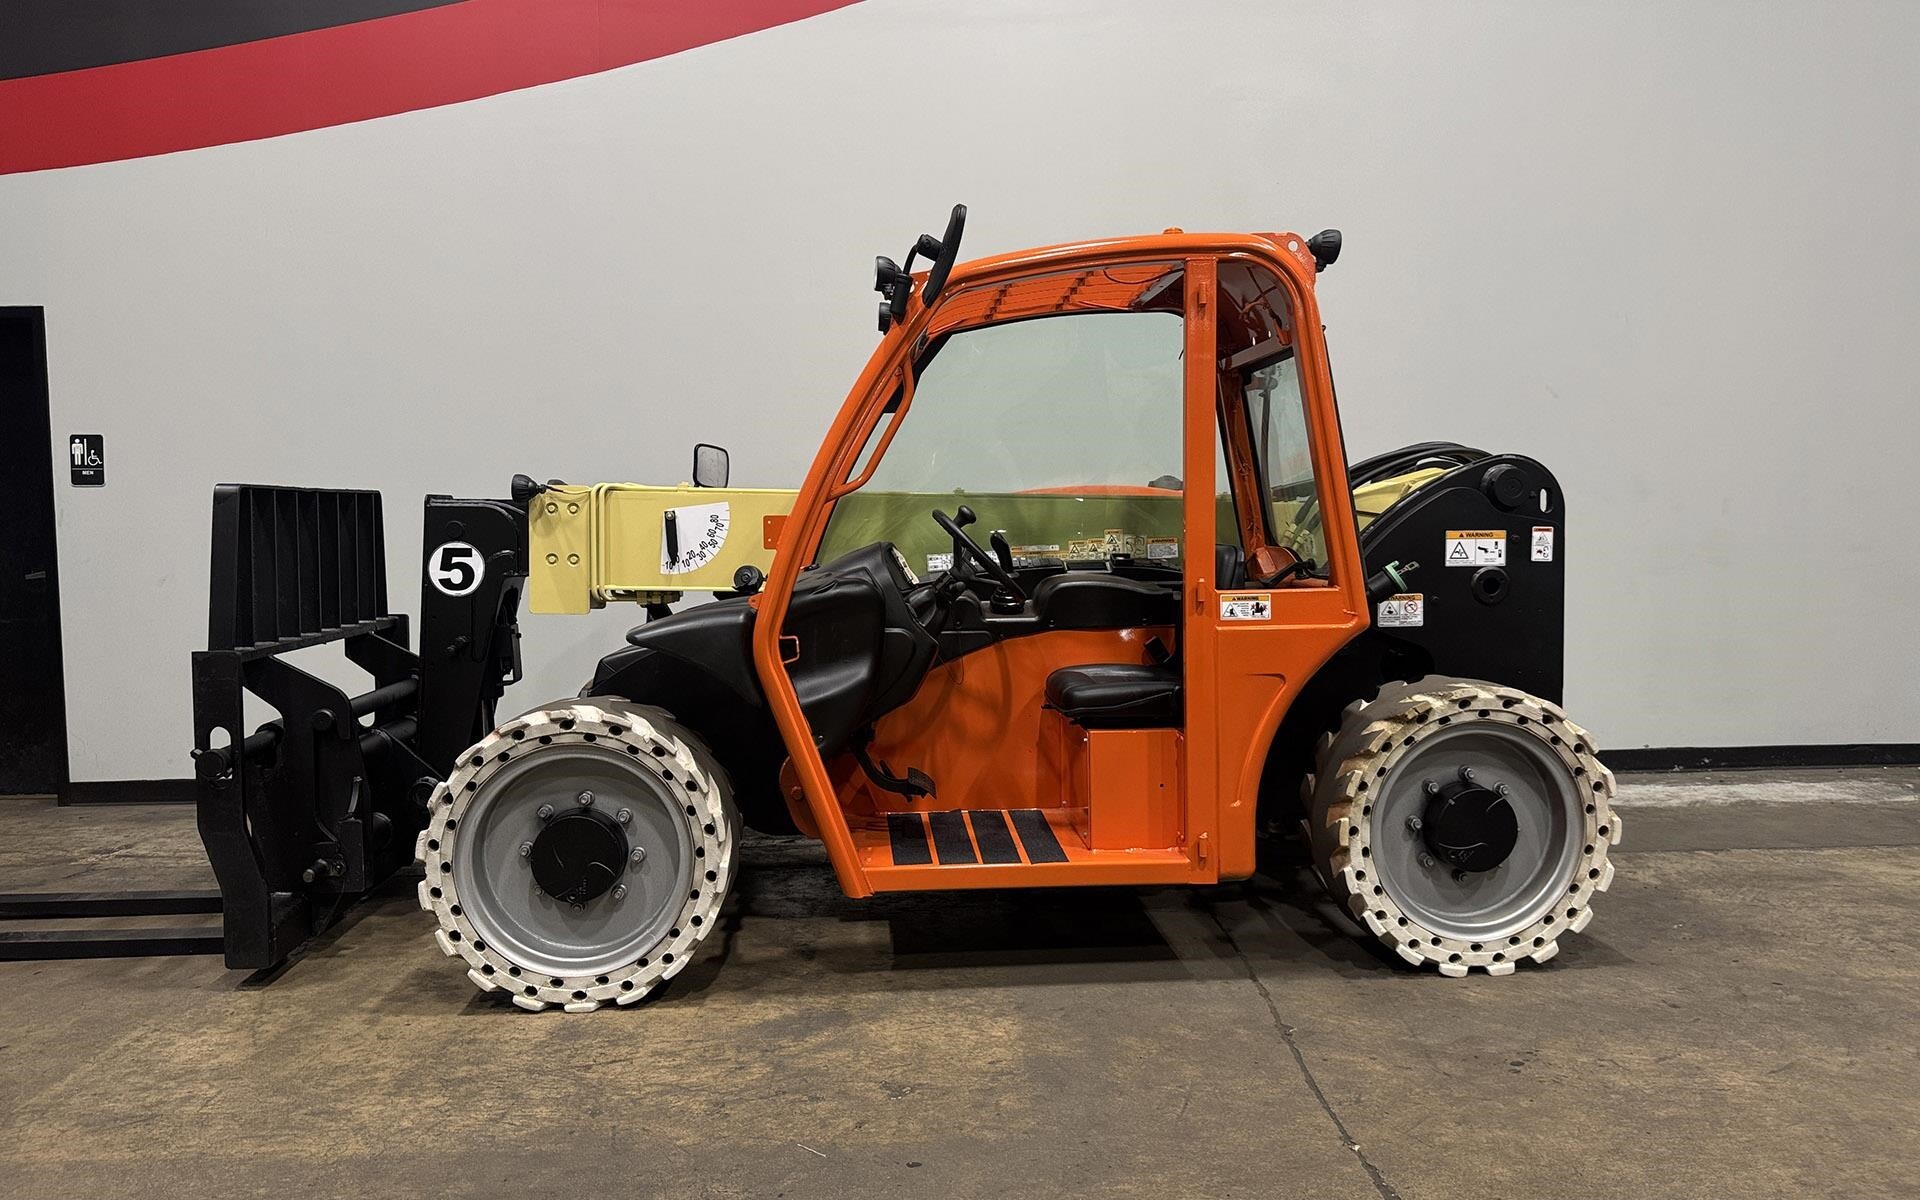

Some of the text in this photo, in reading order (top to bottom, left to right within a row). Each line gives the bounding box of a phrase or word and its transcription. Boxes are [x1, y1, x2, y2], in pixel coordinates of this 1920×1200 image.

[710, 514, 719, 523] 80
[715, 522, 724, 531] 70
[707, 529, 717, 538] 60
[699, 540, 709, 551] 40
[708, 539, 718, 549] 50
[687, 550, 696, 560] 20
[697, 551, 706, 561] 30
[682, 559, 691, 568] 10
[438, 548, 475, 591] 5
